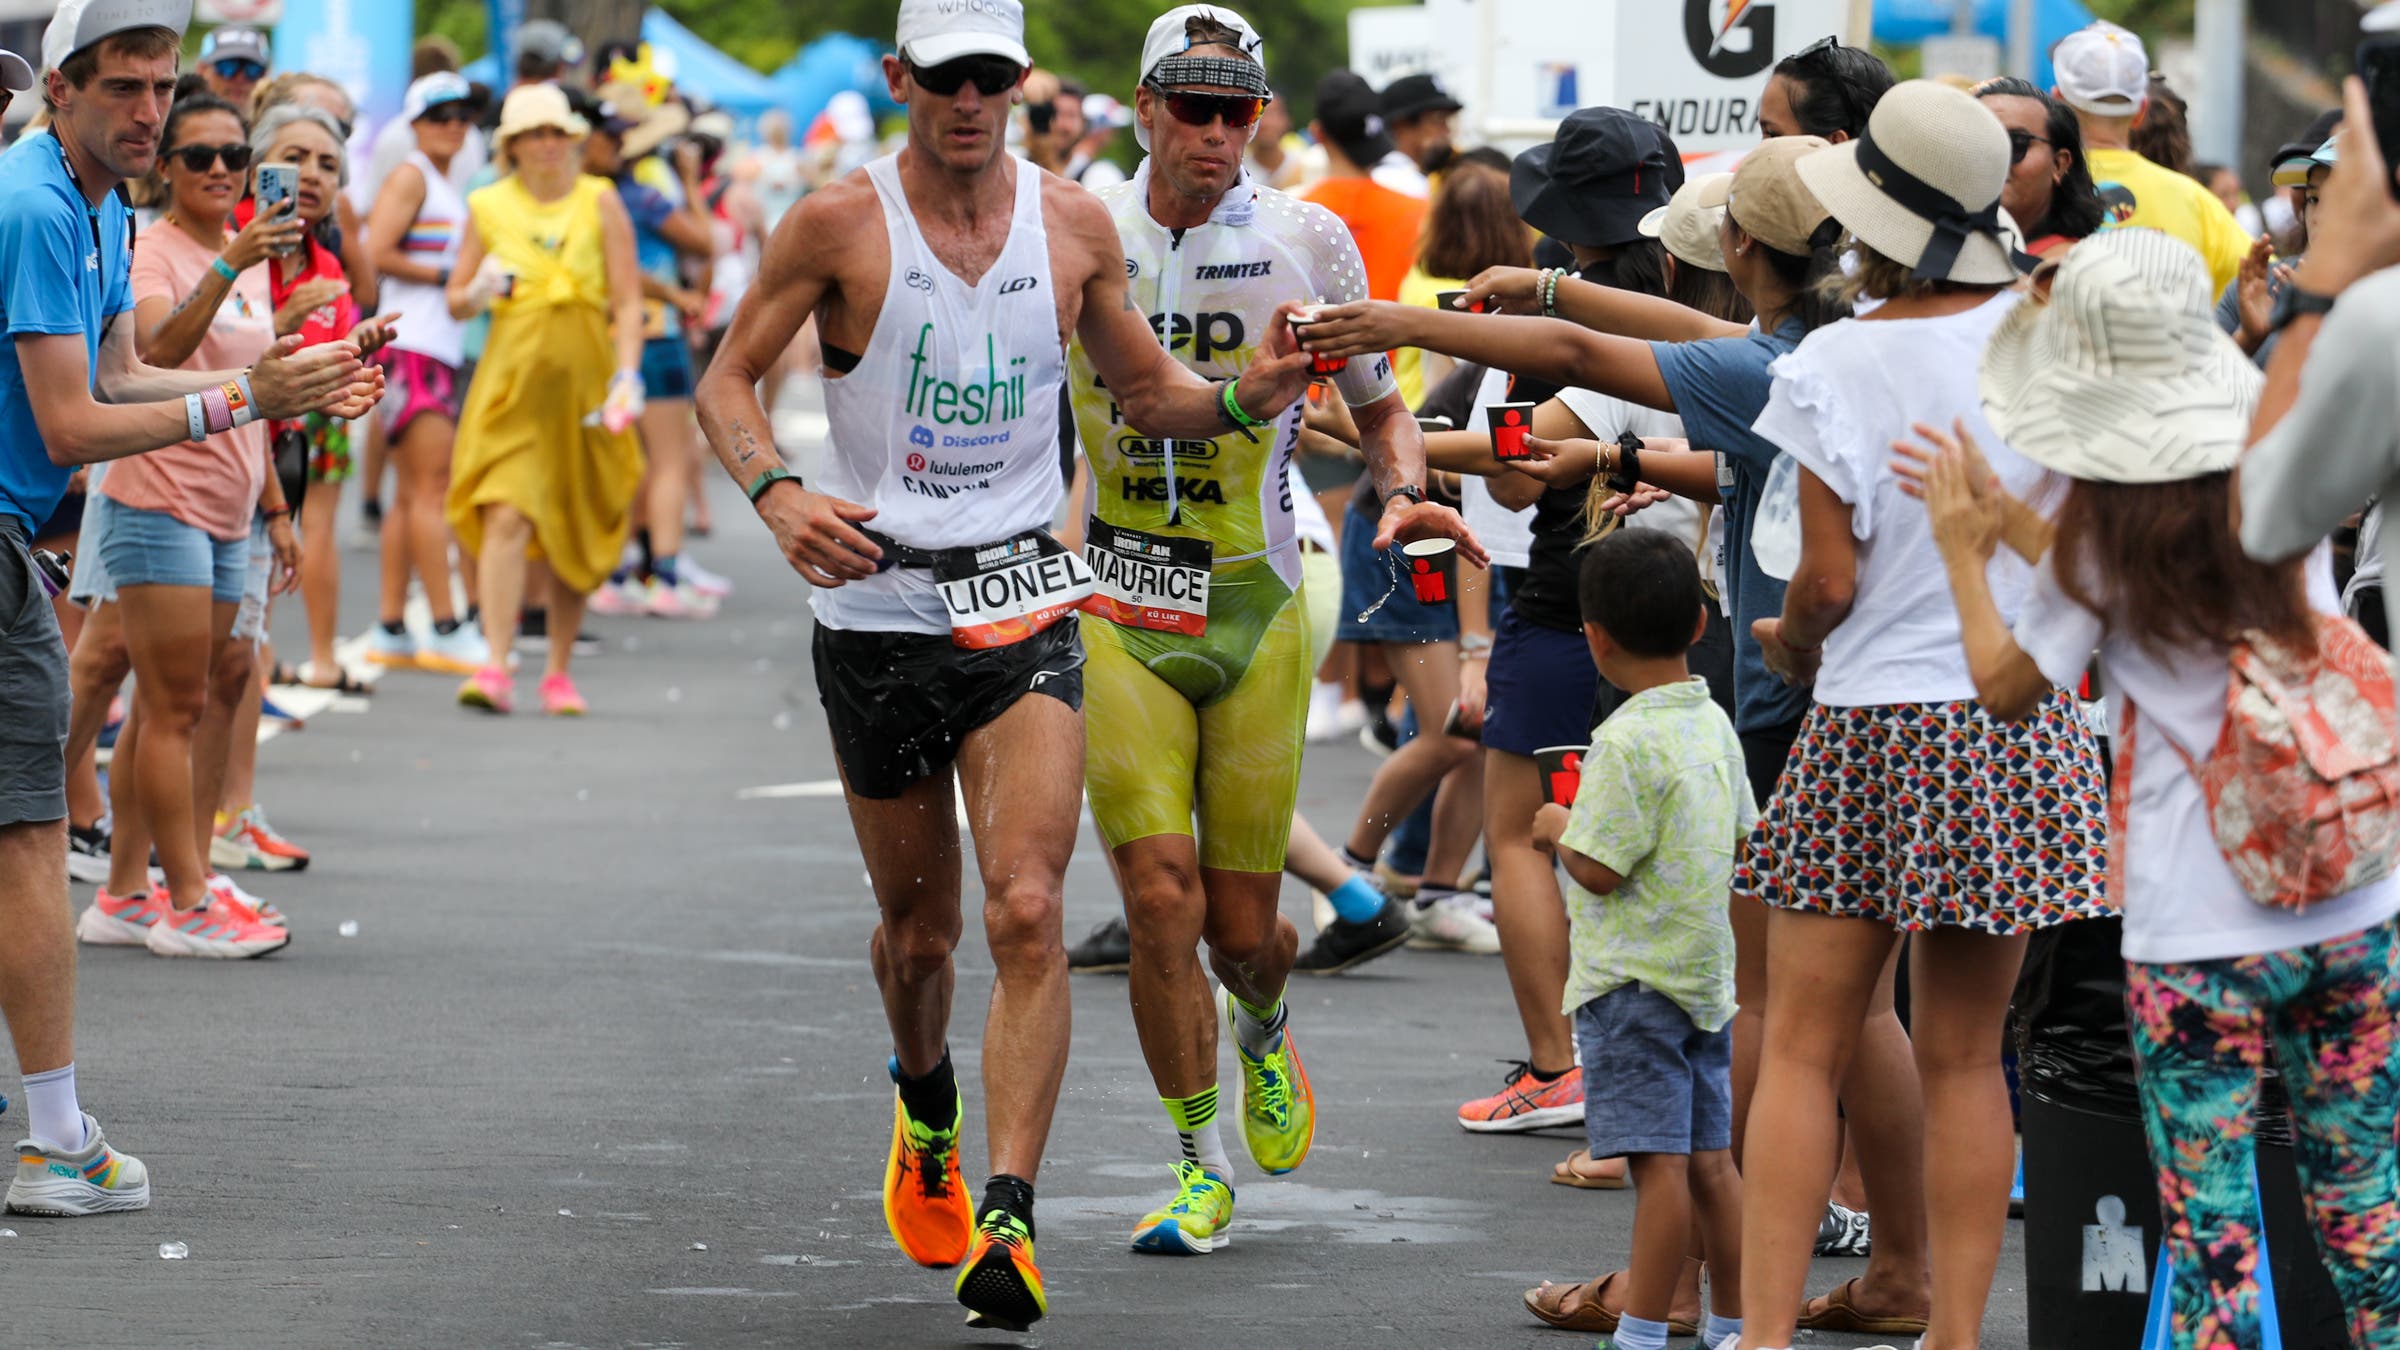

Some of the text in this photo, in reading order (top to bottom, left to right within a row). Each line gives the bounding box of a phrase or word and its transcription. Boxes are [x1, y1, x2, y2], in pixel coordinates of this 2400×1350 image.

[1634, 99, 1760, 134] ENDUR
[1196, 261, 1271, 280] TRIMTEX
[905, 323, 1025, 425] freshii
[943, 430, 1010, 447] Discord
[1128, 440, 1206, 455] ABUS
[930, 460, 1004, 476] lululemon
[1123, 477, 1223, 504] HOKA
[1087, 547, 1204, 603] MAURICE
[944, 555, 1092, 615] LIONEL
[1131, 595, 1143, 603] 50
[1018, 604, 1025, 613] 2
[1161, 613, 1181, 622] LIKE
